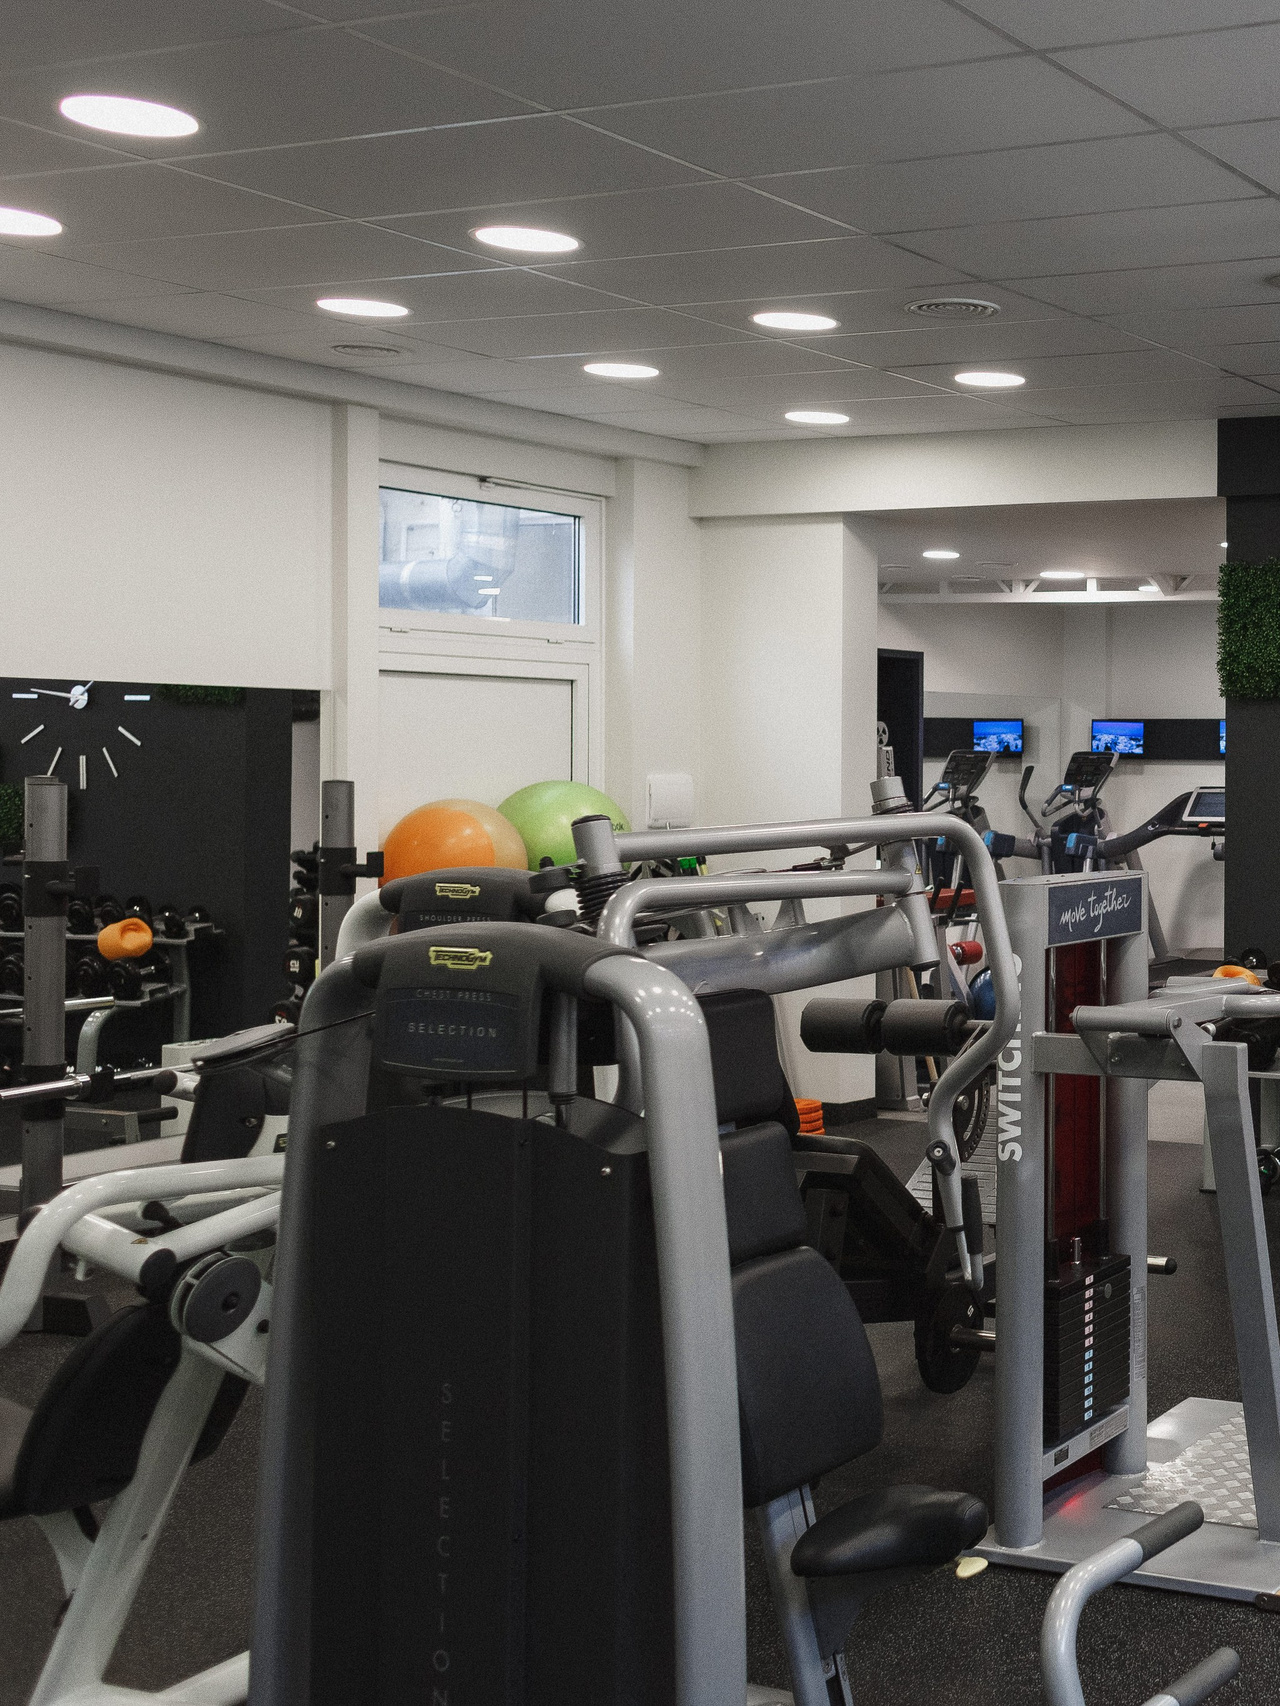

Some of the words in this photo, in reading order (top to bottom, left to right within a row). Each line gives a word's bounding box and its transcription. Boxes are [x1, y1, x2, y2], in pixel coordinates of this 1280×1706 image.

[1059, 900, 1087, 932] move
[1087, 885, 1132, 933] together
[419, 914, 462, 923] SHOULDER
[415, 988, 451, 1000] CHEST
[457, 991, 493, 1002] PRESS
[407, 1022, 498, 1038] SELECTION
